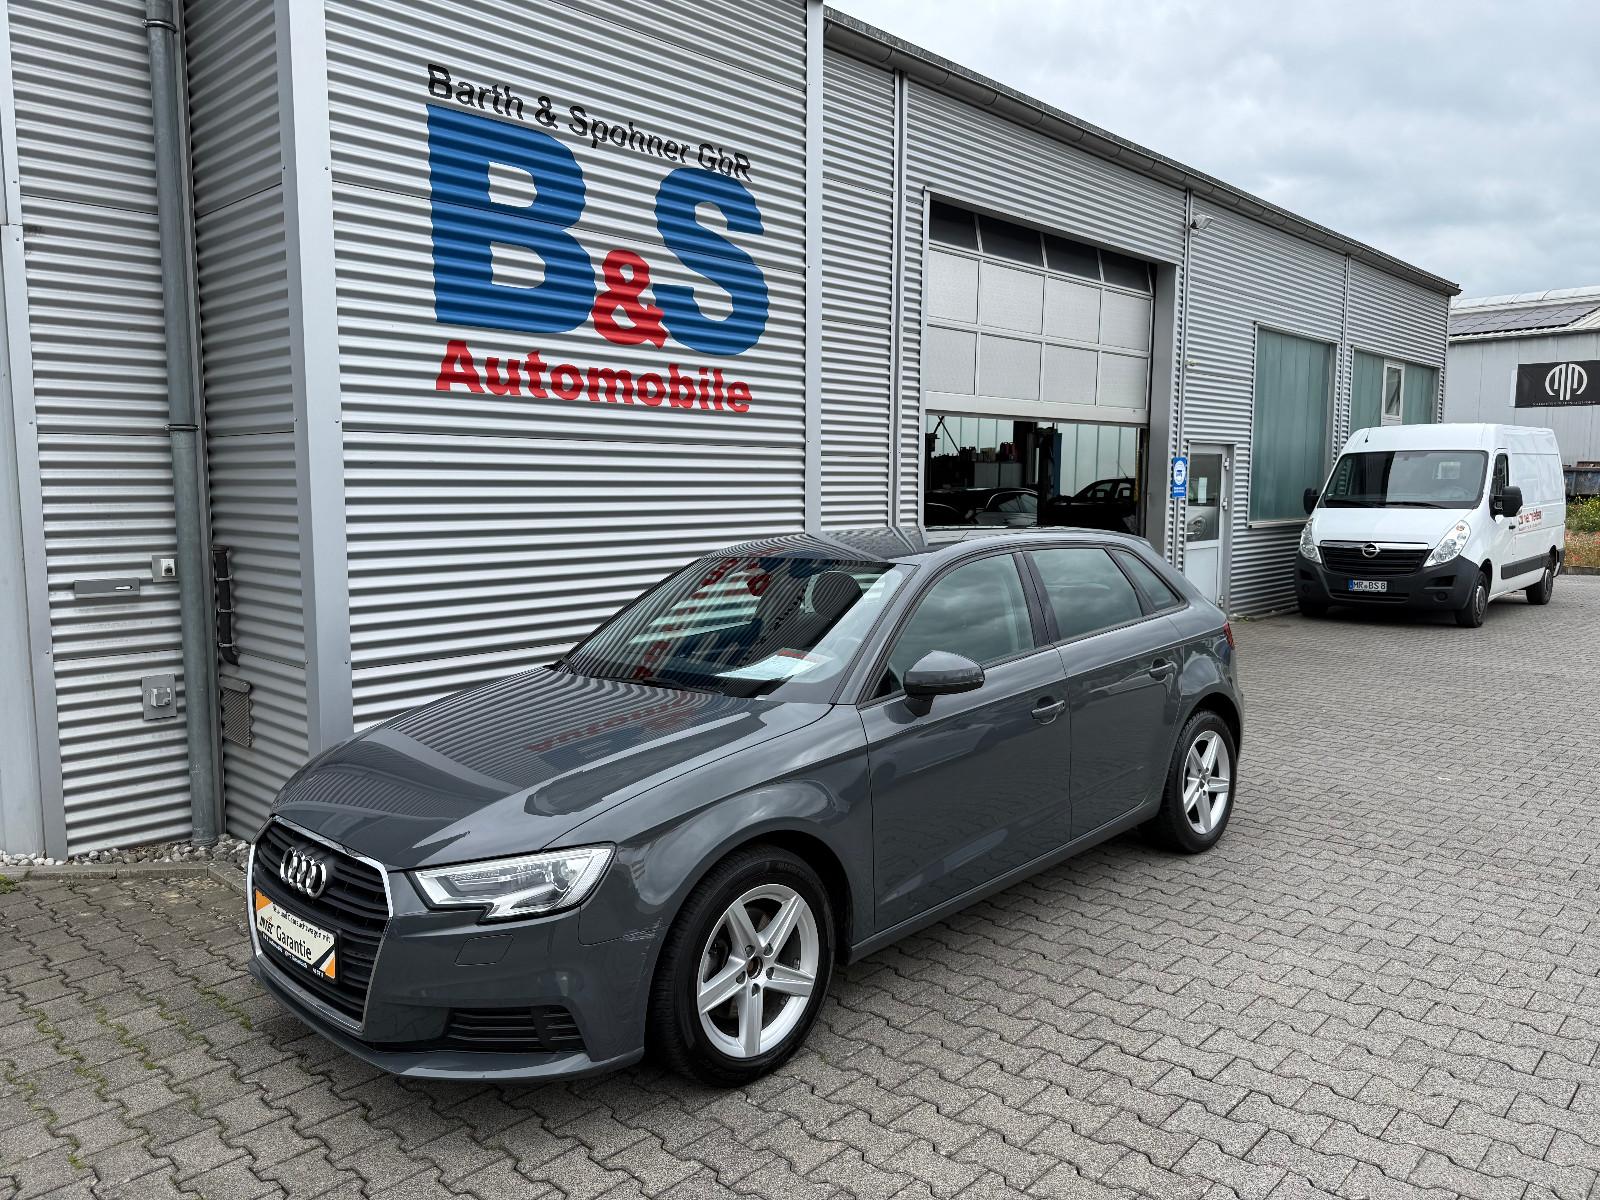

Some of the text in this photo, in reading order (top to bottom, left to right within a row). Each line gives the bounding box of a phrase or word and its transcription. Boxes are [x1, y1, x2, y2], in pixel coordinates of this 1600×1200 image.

[428, 63, 753, 182] Barth & Spohner GbR
[425, 104, 770, 356] B&S
[435, 340, 753, 413] Automobile
[1369, 581, 1379, 590] BS
[276, 924, 312, 961] Garantie
